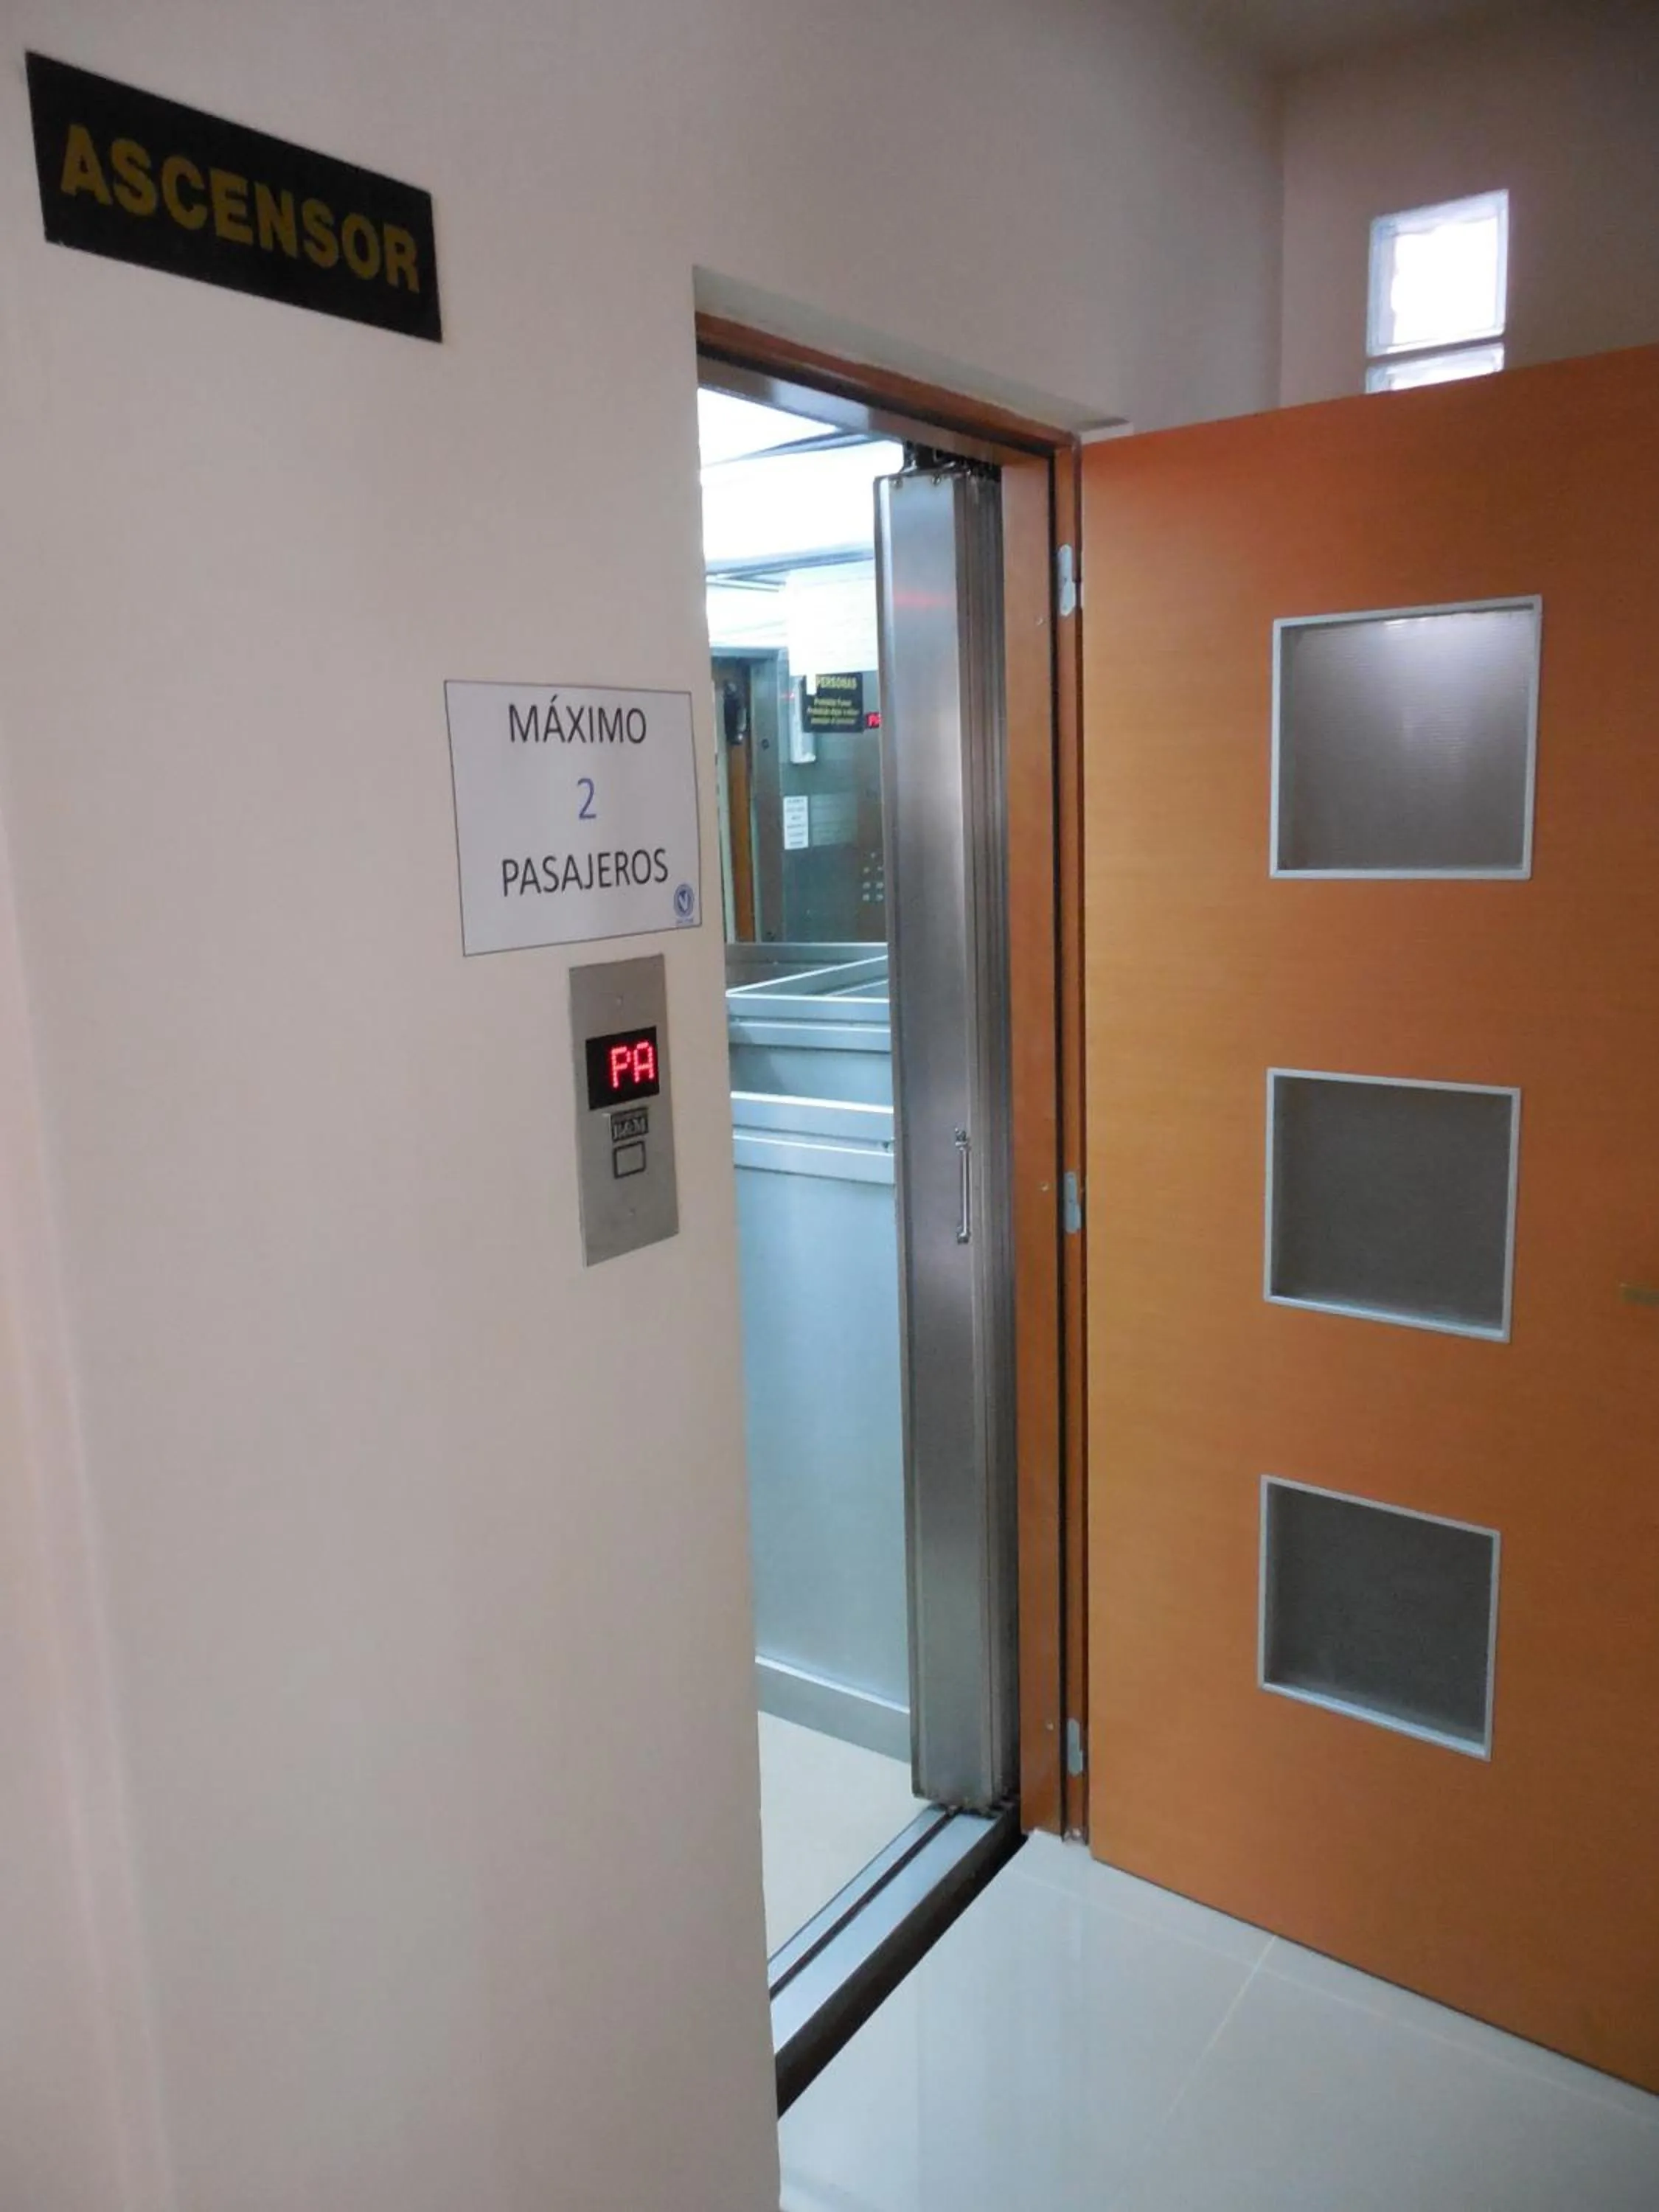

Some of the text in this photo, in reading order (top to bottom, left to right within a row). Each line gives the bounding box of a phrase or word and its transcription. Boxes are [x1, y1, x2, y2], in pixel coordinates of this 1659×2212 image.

[60, 124, 420, 293] ASCENSOR
[509, 694, 647, 744] MÁXIMO
[577, 777, 597, 820] 2
[502, 848, 669, 897] PASAJEROS
[611, 1040, 655, 1088] PA
